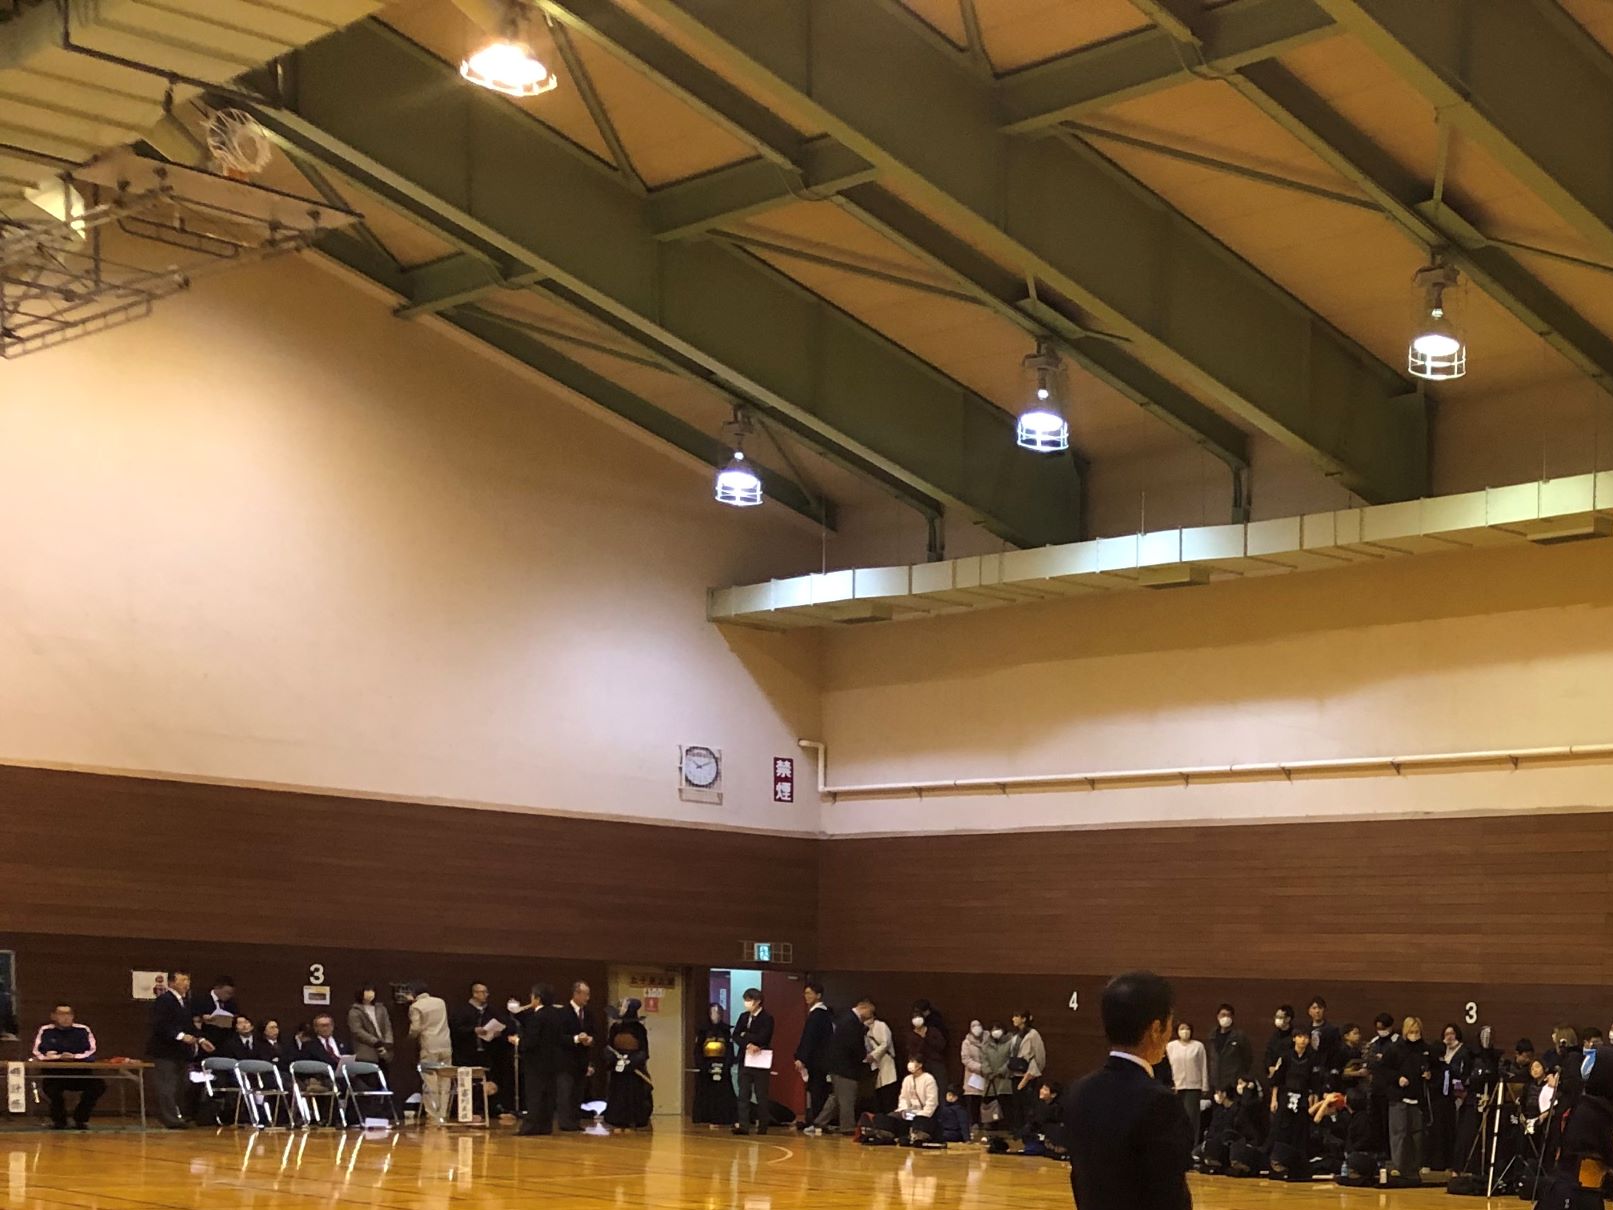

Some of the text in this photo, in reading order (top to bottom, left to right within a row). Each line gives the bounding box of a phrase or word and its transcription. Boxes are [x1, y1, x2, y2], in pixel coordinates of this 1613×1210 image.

[776, 759, 791, 800] 禁煙
[310, 963, 325, 985] 3
[1069, 991, 1079, 1011] 4
[1465, 1001, 1477, 1024] 3
